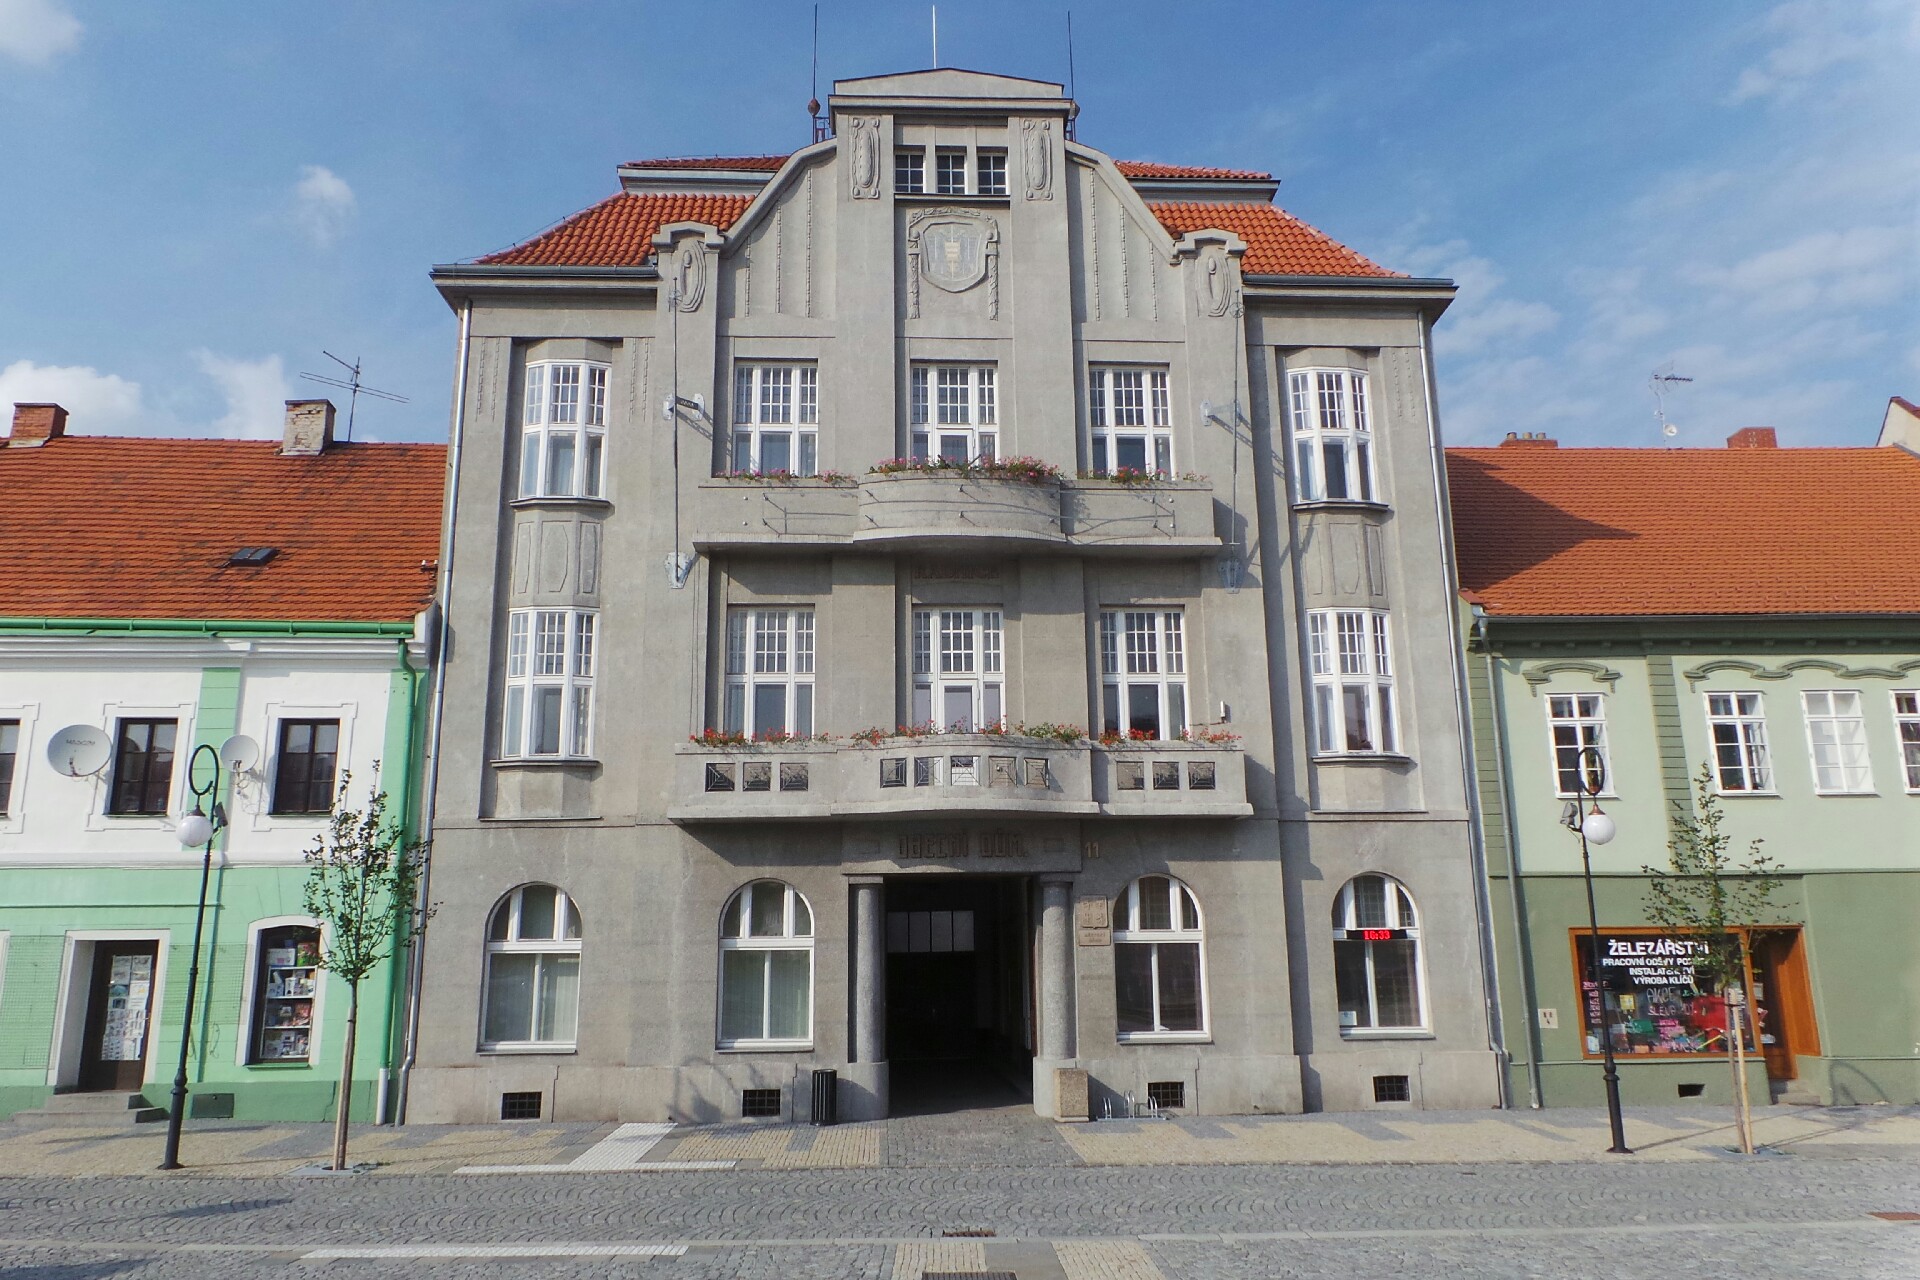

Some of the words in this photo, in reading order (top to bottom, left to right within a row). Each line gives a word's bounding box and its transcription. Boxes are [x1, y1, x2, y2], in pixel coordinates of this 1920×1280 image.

[1085, 841, 1100, 858] 11
[1364, 930, 1391, 940] 16:33
[1602, 957, 1645, 966] PRACOVNÍ
[1629, 966, 1695, 975] INSTALATTVÍ
[1633, 974, 1669, 984] VÝROBA
